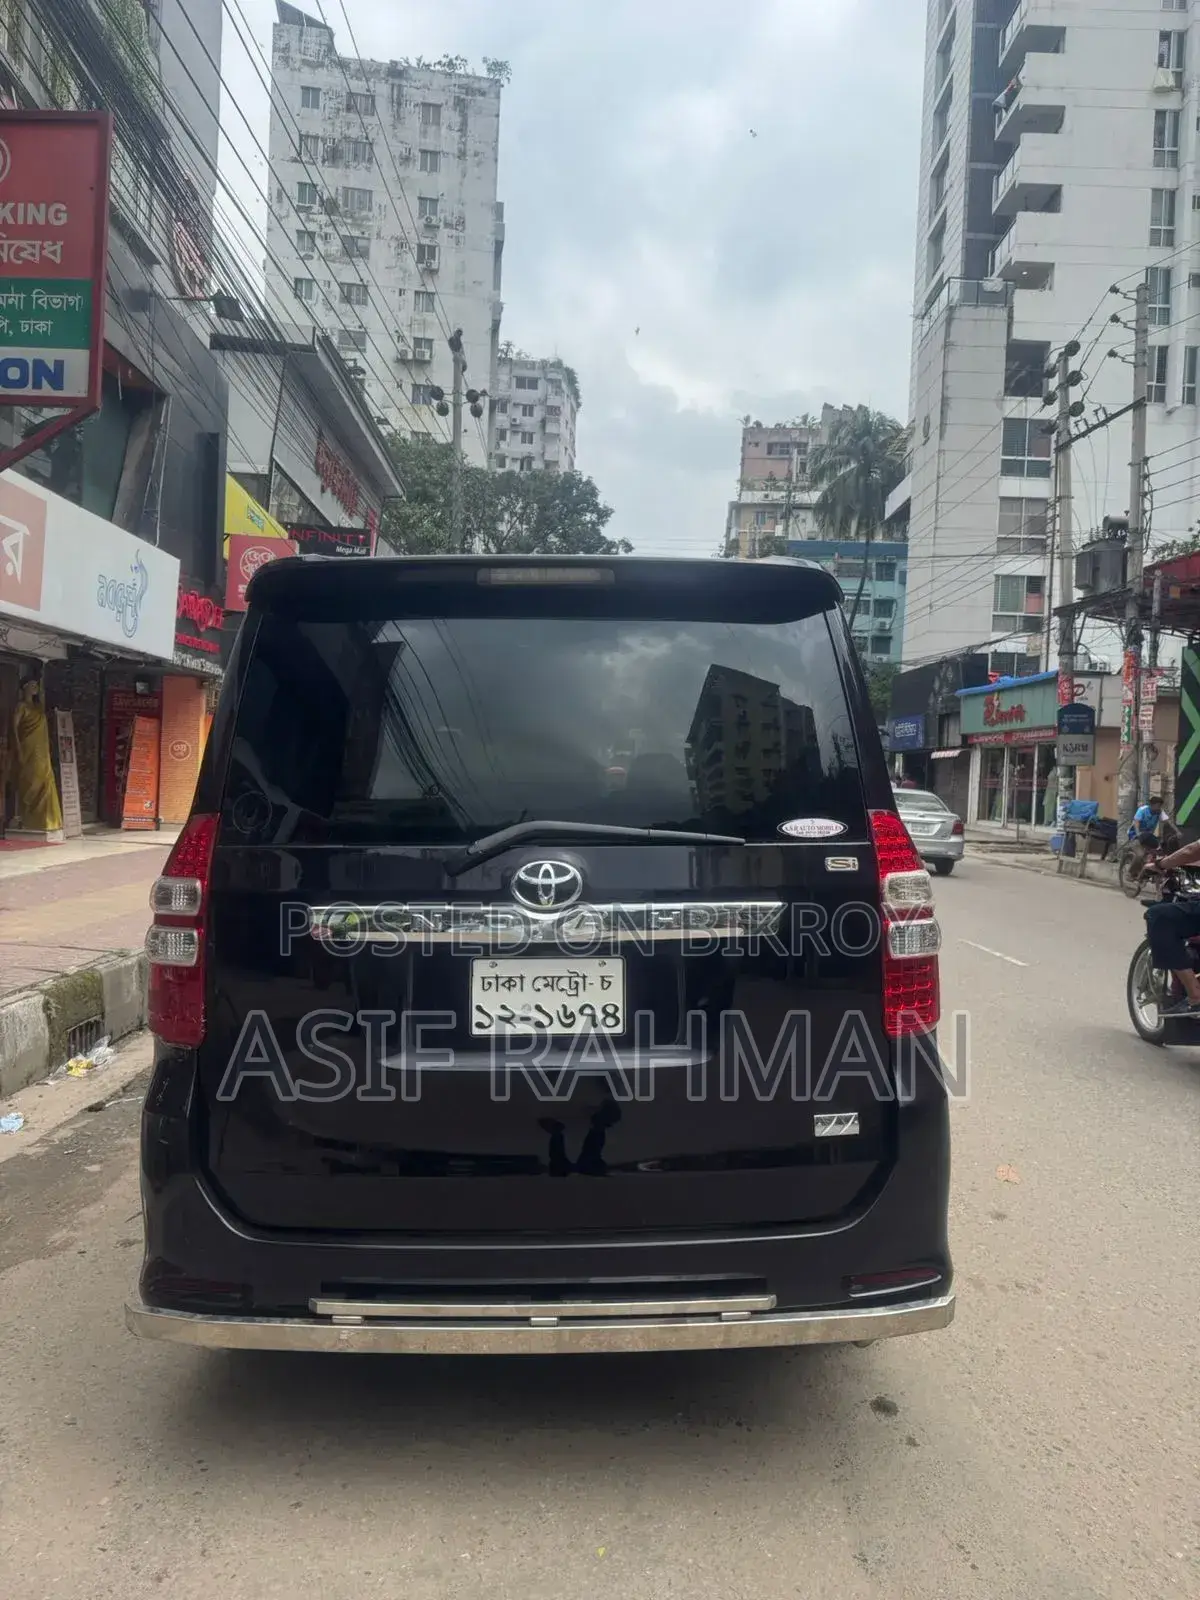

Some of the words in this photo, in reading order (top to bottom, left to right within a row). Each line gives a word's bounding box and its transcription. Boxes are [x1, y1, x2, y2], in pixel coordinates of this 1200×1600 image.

[19, 318, 54, 337] ঢাকা
[335, 545, 353, 555] Mega
[829, 858, 857, 870] Si
[480, 971, 525, 994] ঢাকা
[599, 974, 615, 993] চ
[474, 1002, 621, 1031] ১২-১৬৭৪
